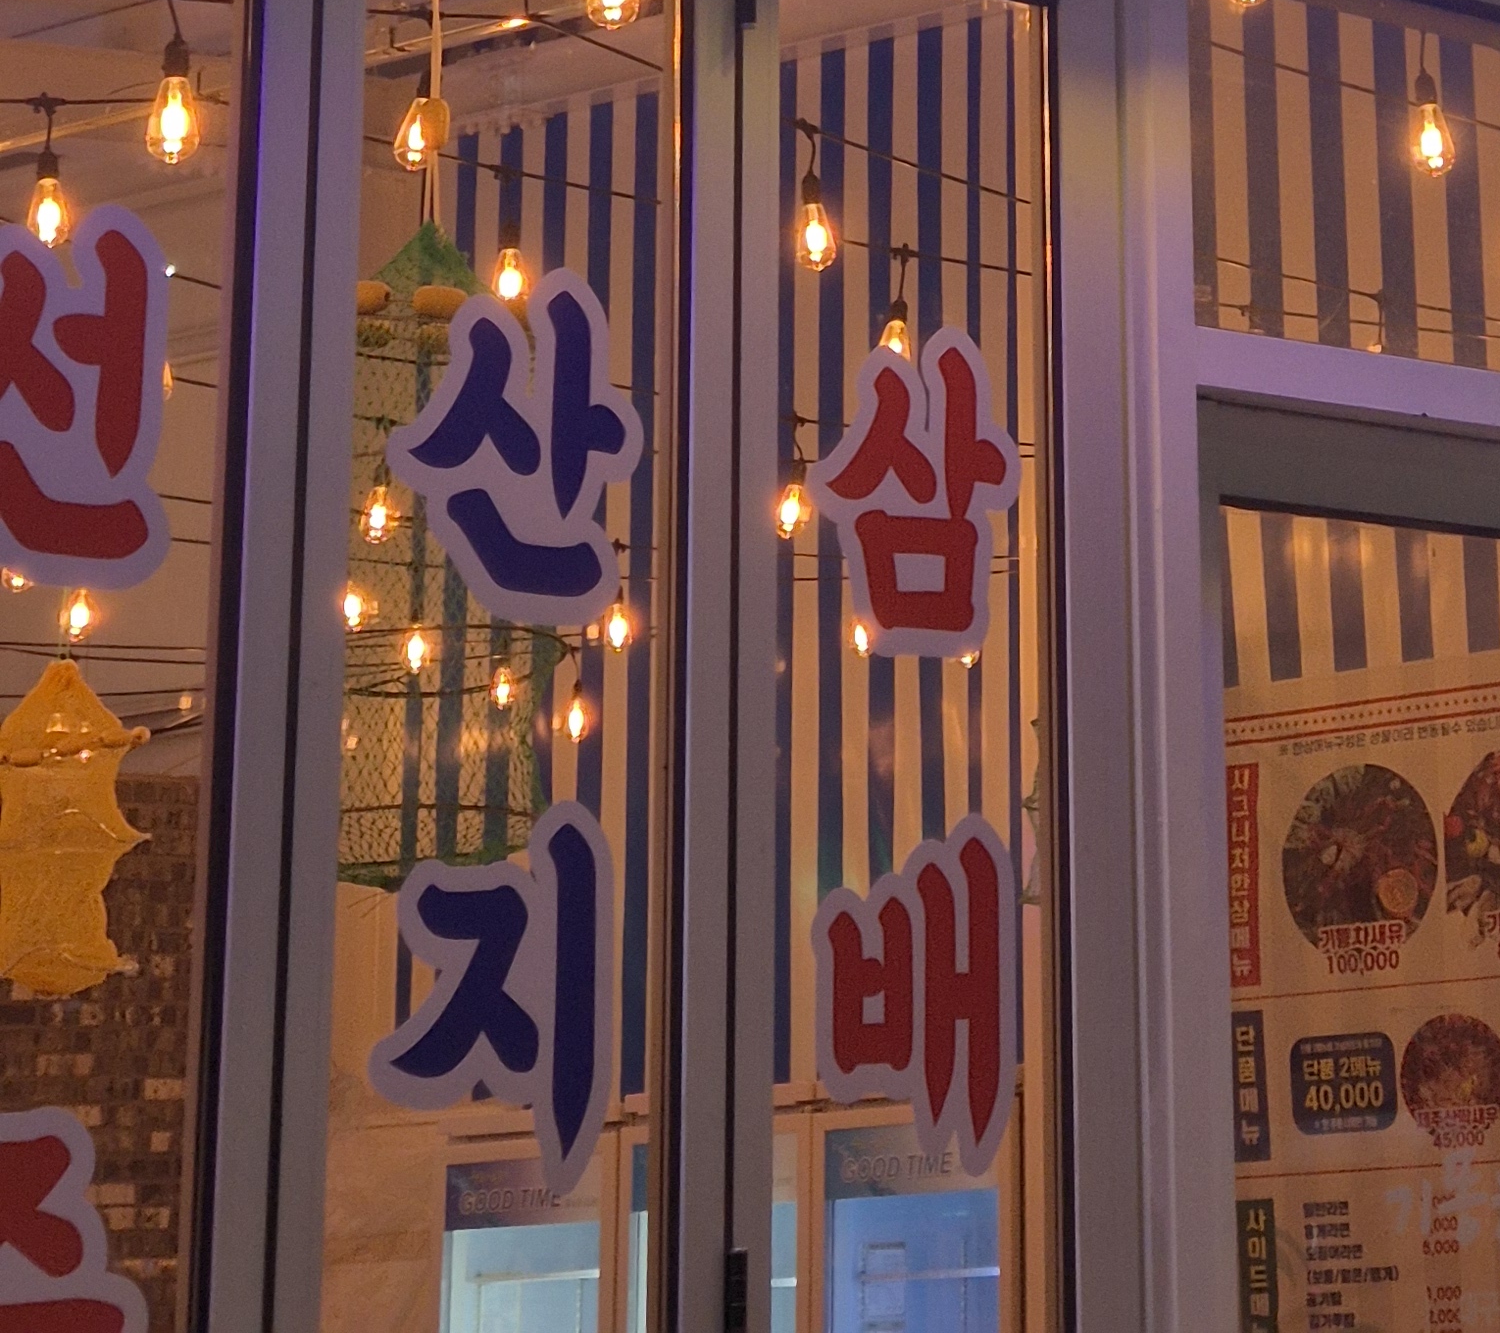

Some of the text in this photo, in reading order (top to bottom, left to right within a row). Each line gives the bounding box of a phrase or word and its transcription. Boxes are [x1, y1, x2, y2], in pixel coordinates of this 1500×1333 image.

[1326, 949, 1400, 977] 100,000
[1304, 1080, 1384, 1115] 40,000
[840, 1151, 952, 1184] GOOD TIME
[459, 1189, 515, 1216] GOOD
